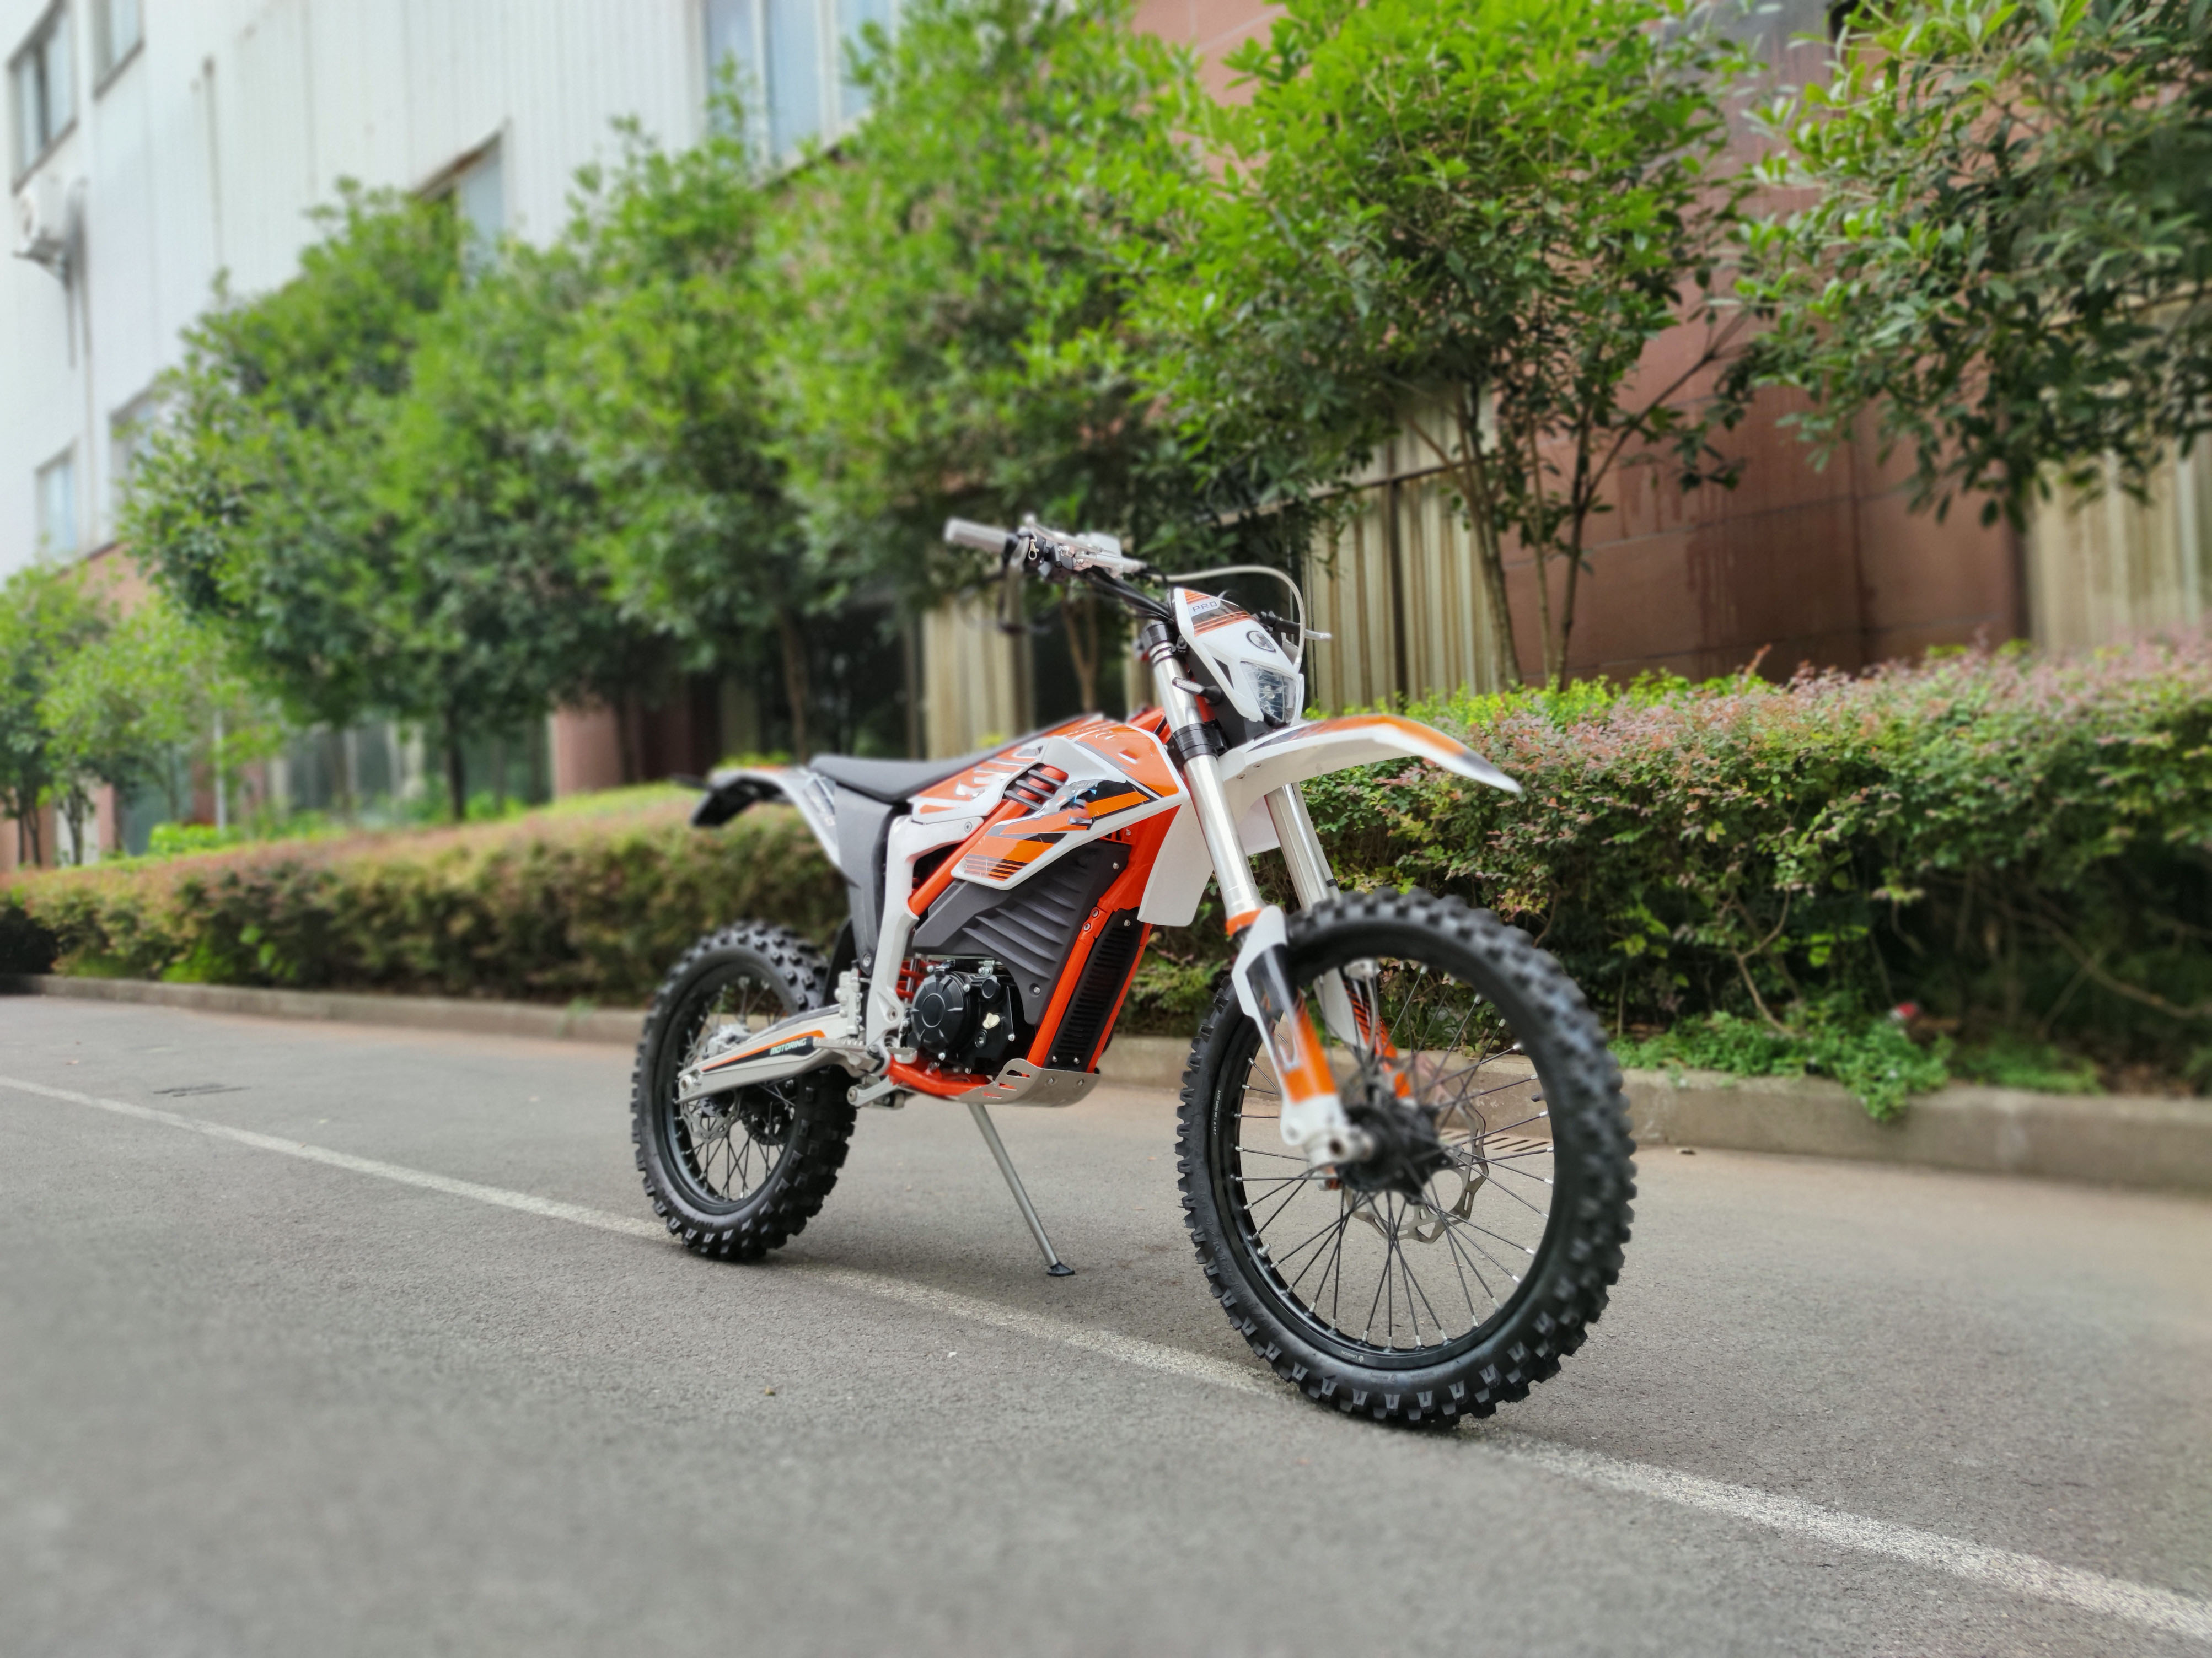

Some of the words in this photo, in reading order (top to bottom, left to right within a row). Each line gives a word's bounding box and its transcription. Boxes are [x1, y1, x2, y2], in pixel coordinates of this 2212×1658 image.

[1192, 601, 1218, 612] PRO
[769, 1037, 807, 1056] MOTORING
[1341, 1350, 1358, 1359] UNISON
